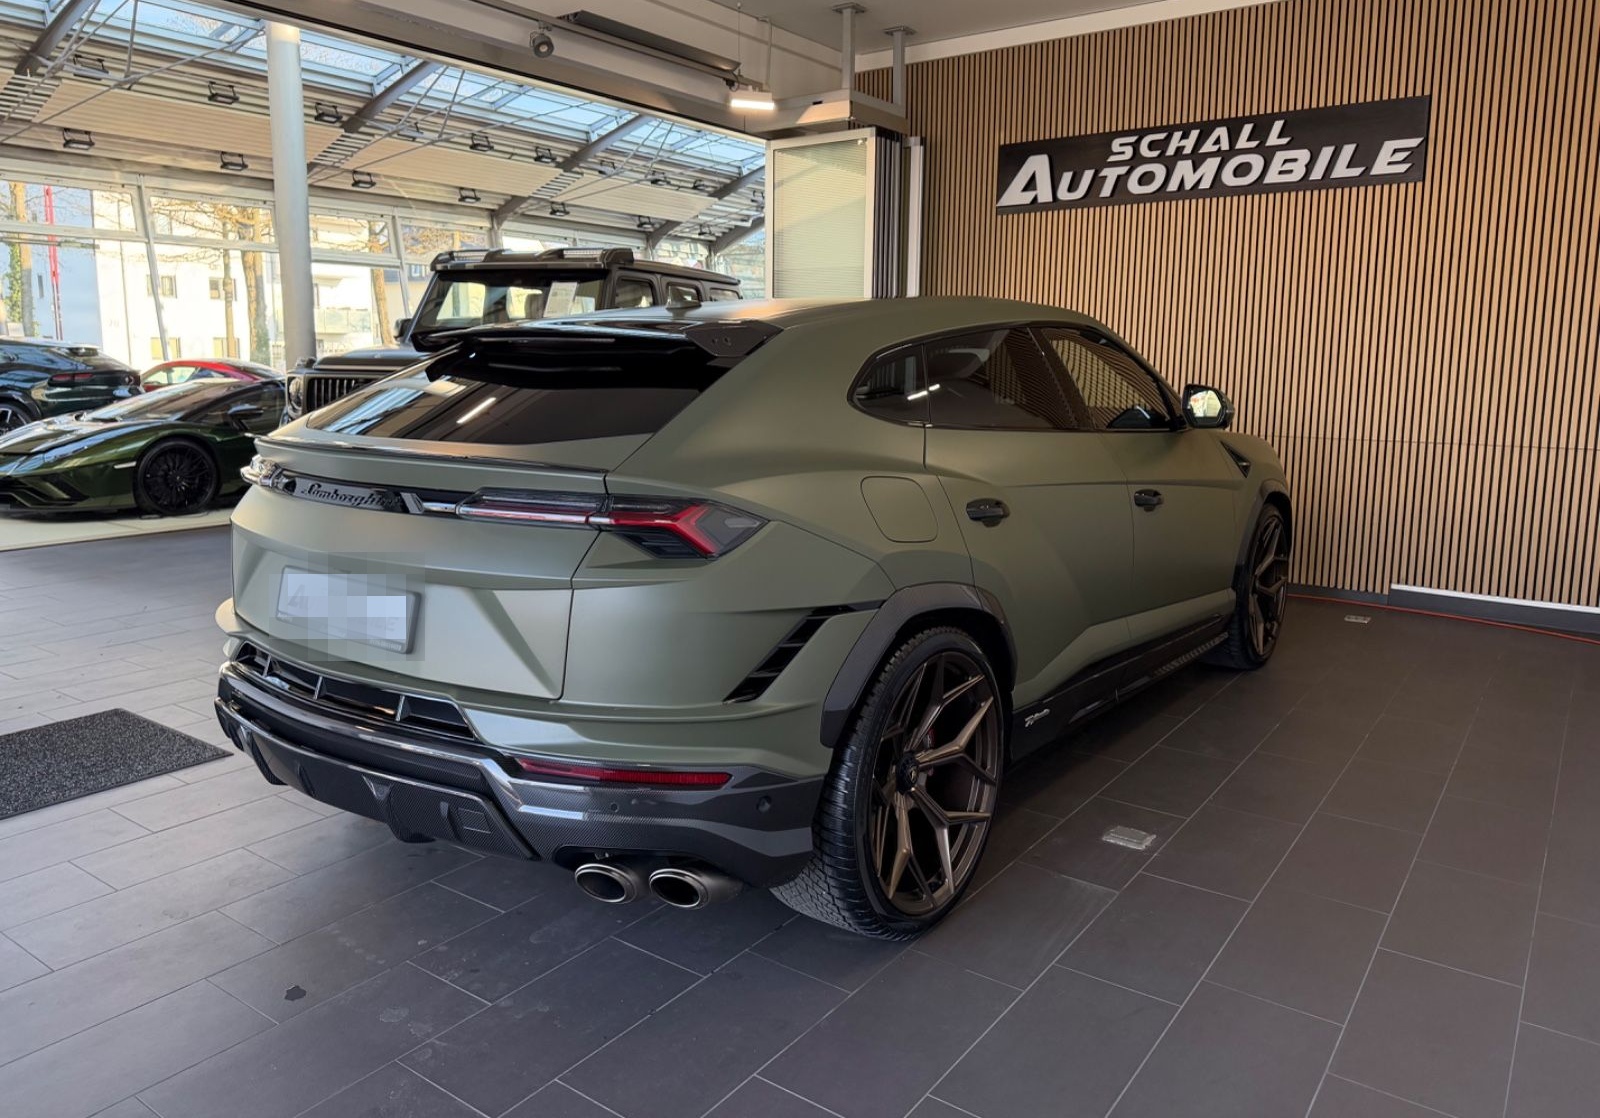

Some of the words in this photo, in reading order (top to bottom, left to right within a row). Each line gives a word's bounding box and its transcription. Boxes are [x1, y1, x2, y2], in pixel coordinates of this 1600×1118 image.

[1107, 119, 1293, 163] SCHALL
[996, 136, 1425, 207] AUTOMOBILE
[301, 483, 399, 508] Lamborghi
